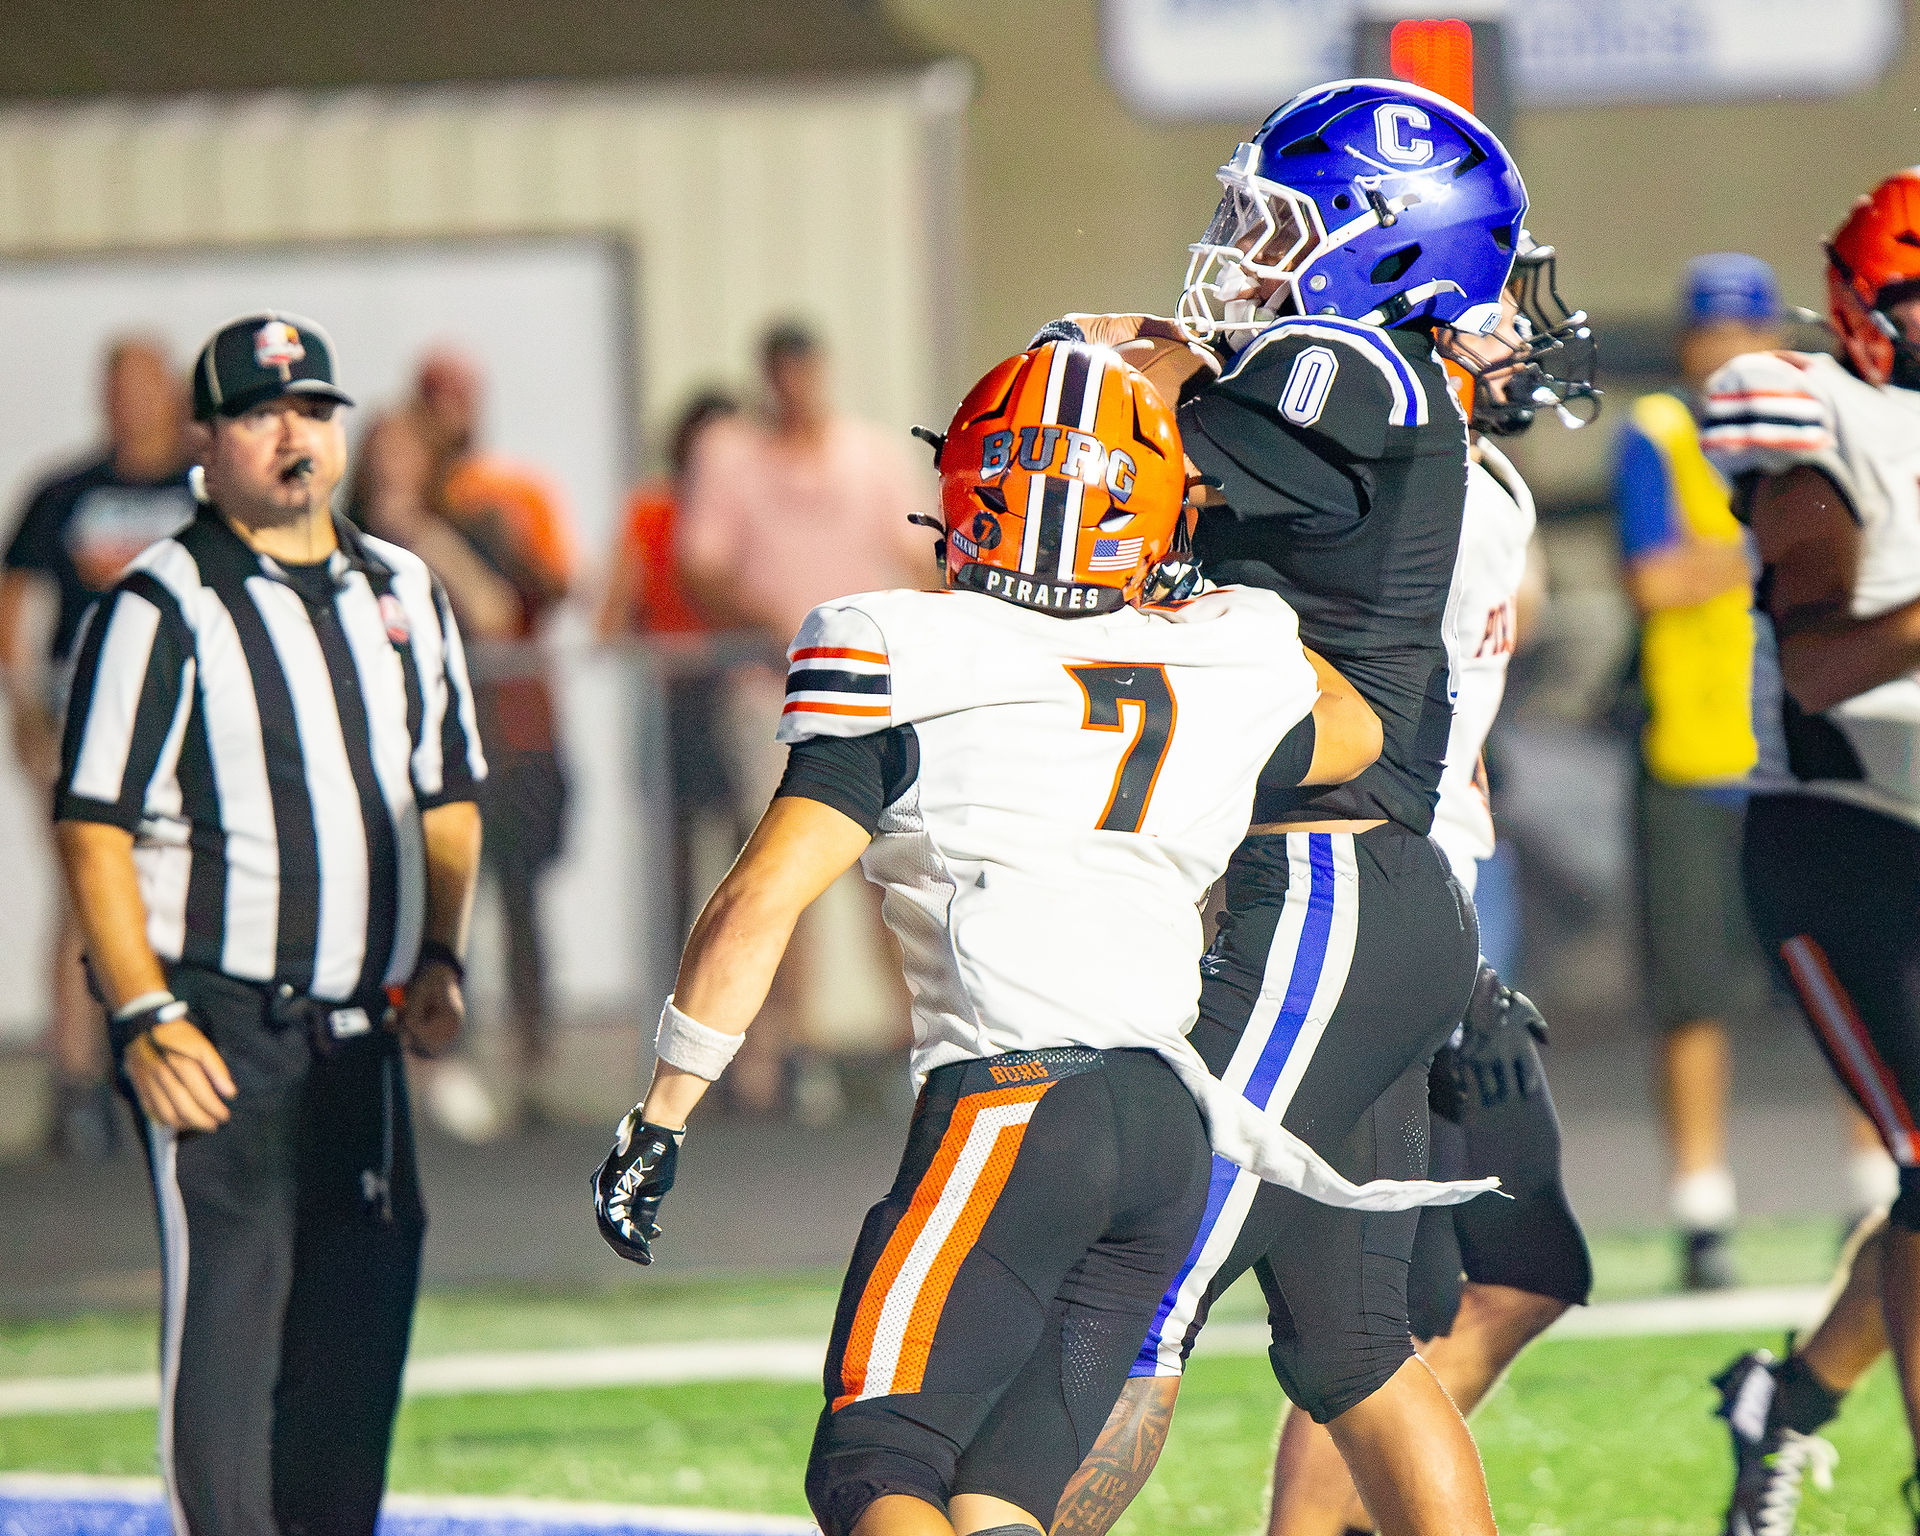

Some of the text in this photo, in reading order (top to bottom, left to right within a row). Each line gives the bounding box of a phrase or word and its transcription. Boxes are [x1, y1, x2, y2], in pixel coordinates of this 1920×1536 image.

[979, 426, 1137, 503] BURG
[986, 570, 1099, 609] PIRATES
[1061, 663, 1178, 833] 7
[988, 1060, 1049, 1085] BURG
